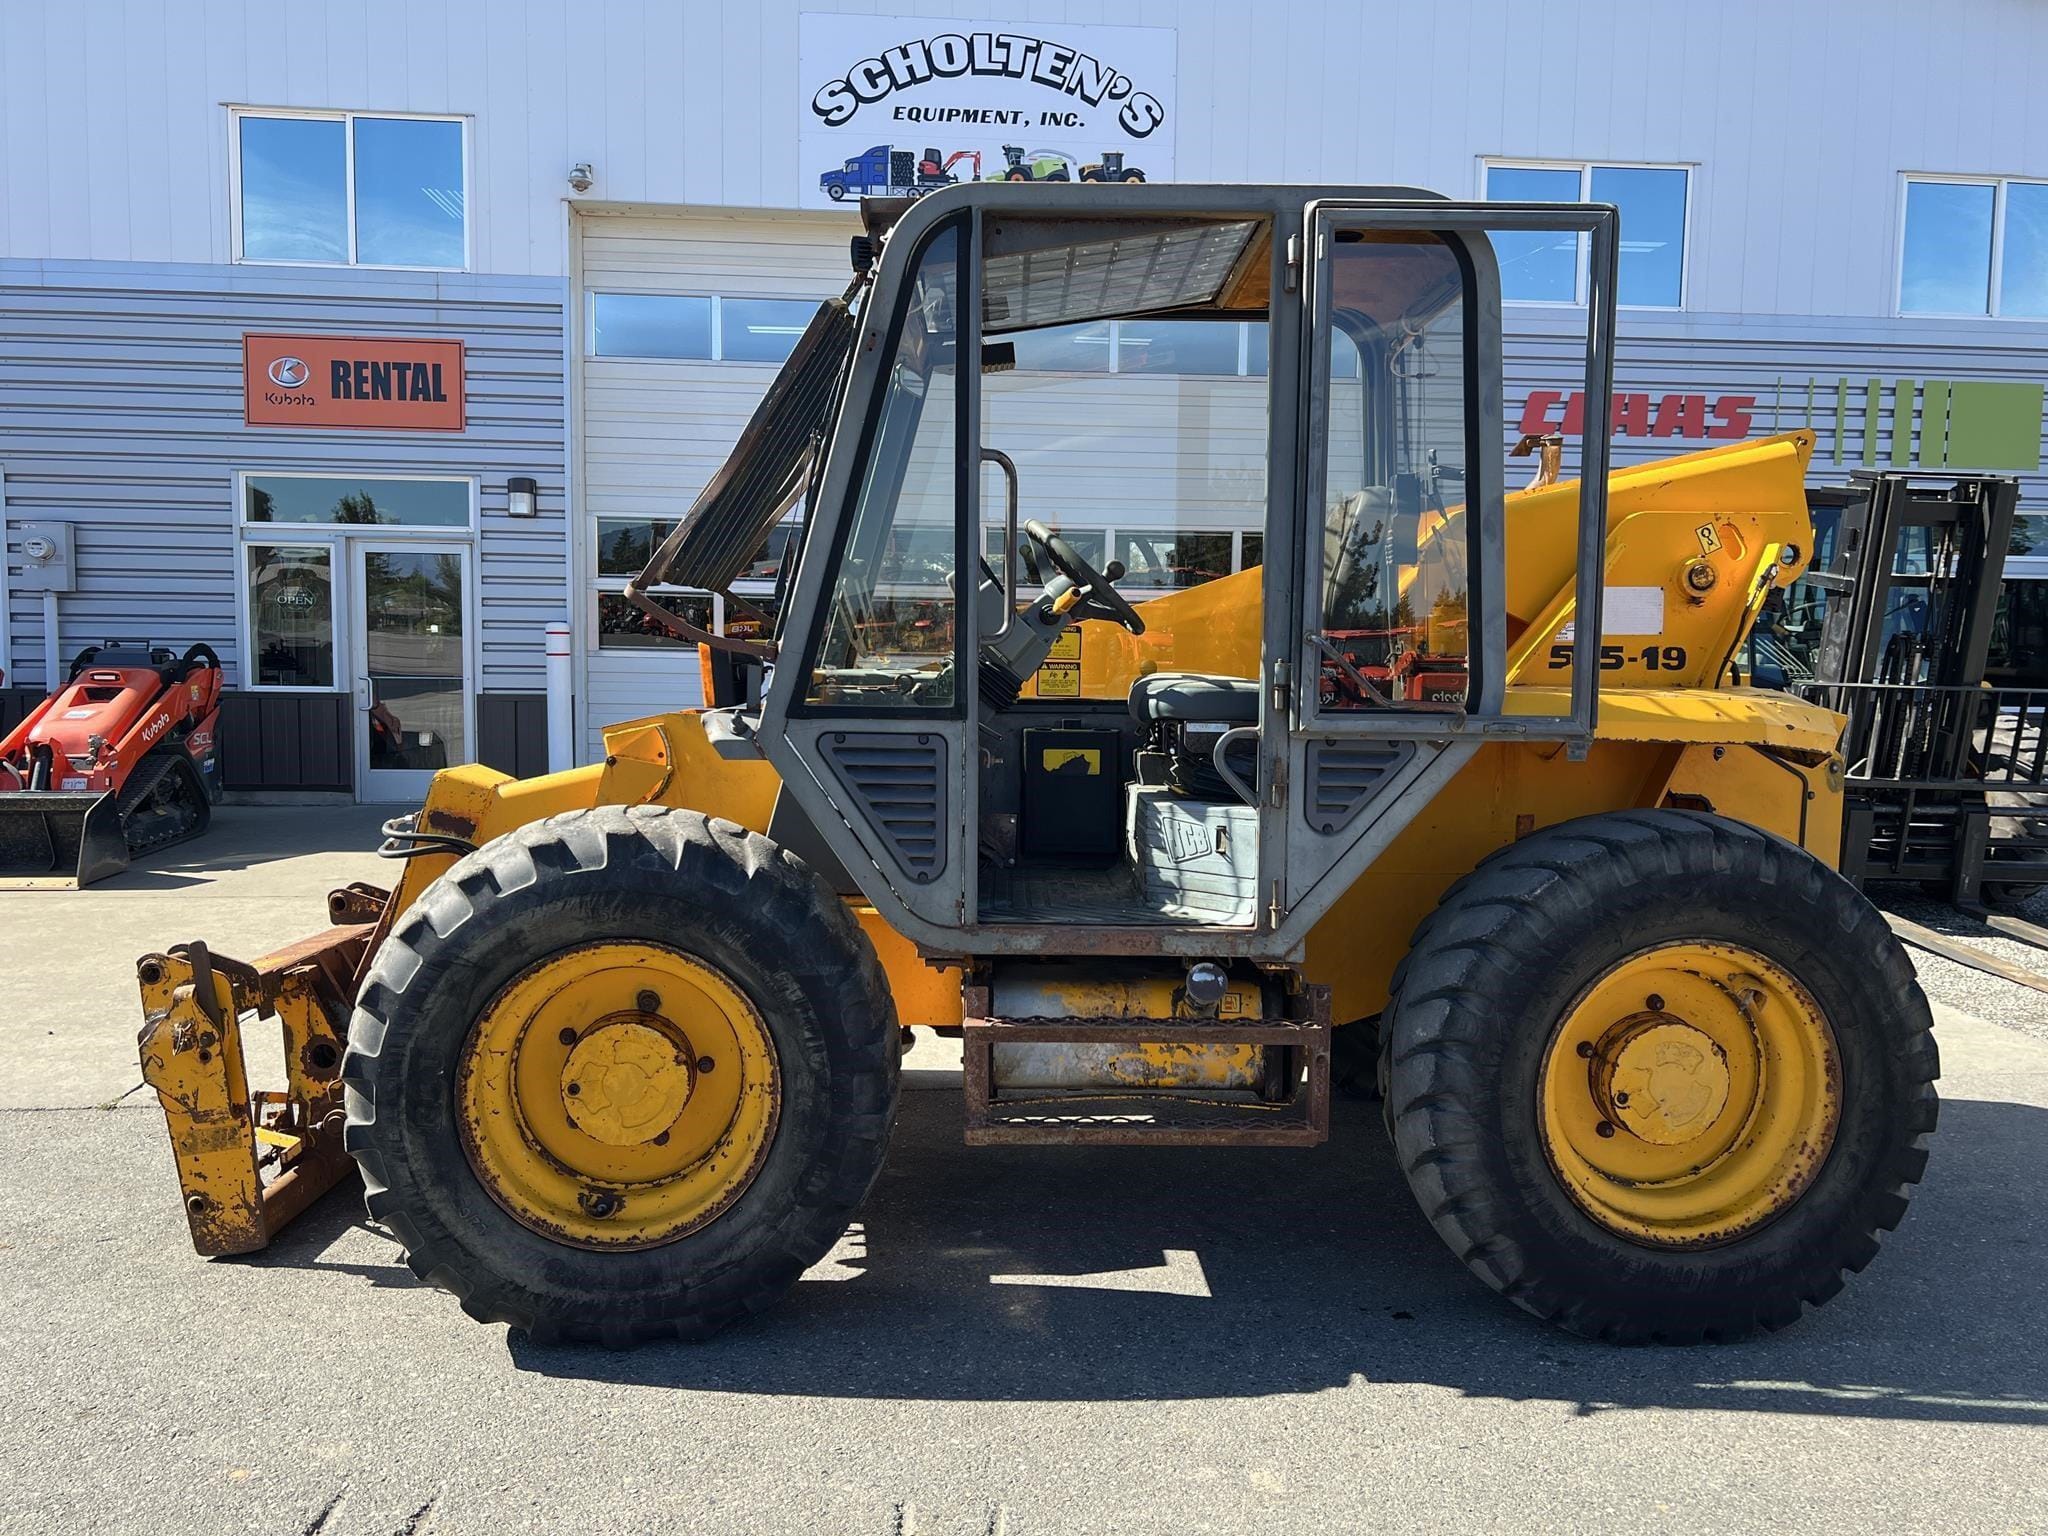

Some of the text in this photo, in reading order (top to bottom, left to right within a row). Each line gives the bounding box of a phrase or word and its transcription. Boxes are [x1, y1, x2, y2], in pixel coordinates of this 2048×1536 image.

[812, 33, 1164, 138] SCHOLTEN'S
[893, 106, 1086, 128] EQUIPMENT, INC.
[331, 360, 447, 402] RENTAL
[265, 392, 315, 406] Kubota
[277, 596, 313, 605] OPEN
[1048, 663, 1078, 671] WARNING
[1548, 644, 1687, 671] 55-19
[142, 713, 170, 741] Kubota
